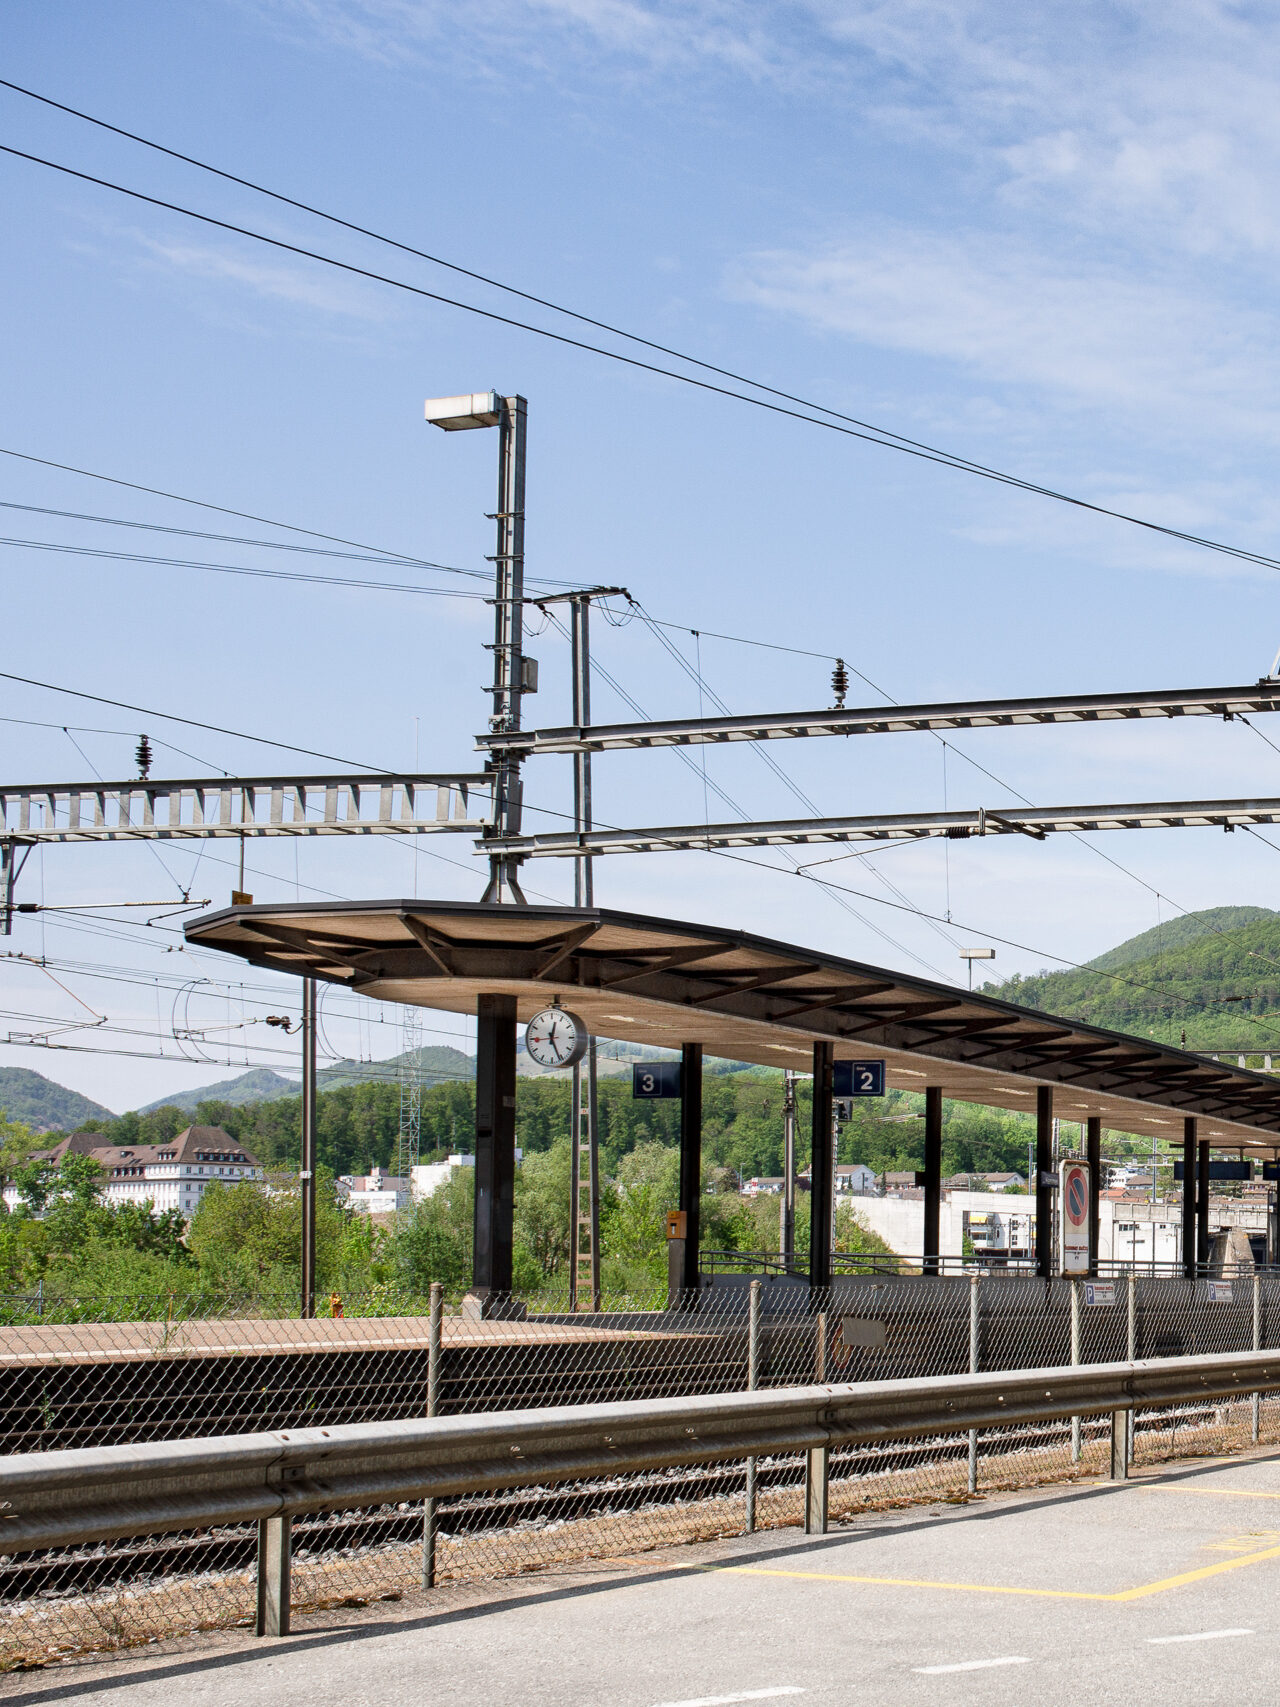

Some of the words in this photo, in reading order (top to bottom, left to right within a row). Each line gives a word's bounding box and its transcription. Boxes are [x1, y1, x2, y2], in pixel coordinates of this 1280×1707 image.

[642, 1074, 654, 1092] 3
[861, 1072, 873, 1090] 2
[1088, 1287, 1093, 1303] P
[1210, 1285, 1214, 1297] P
